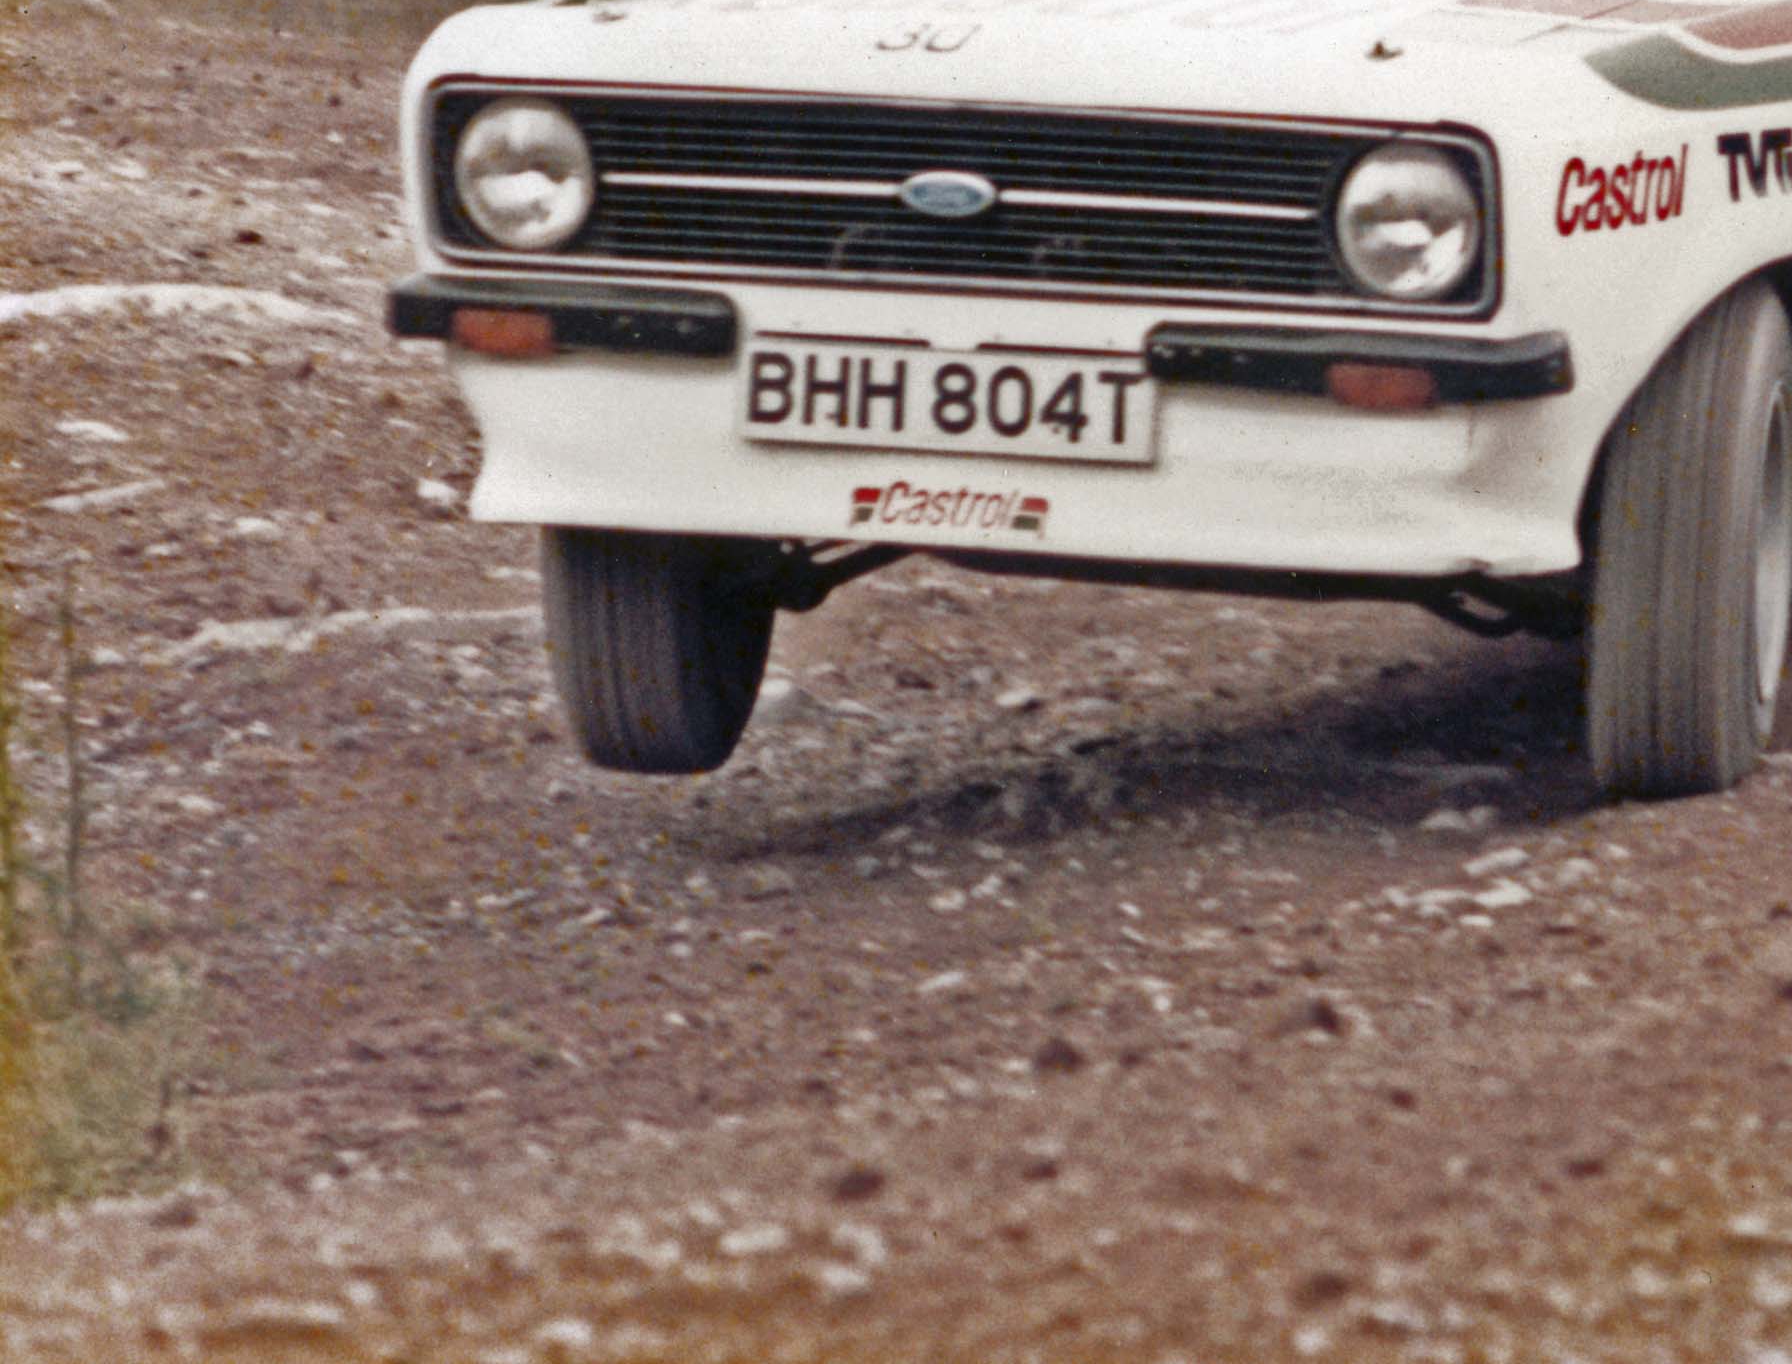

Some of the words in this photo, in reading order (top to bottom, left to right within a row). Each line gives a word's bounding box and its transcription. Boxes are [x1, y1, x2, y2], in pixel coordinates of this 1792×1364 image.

[1555, 141, 1689, 237] Castrol
[748, 350, 908, 433] BHH
[931, 361, 1152, 445] 804T
[879, 479, 1019, 529] Castrol
